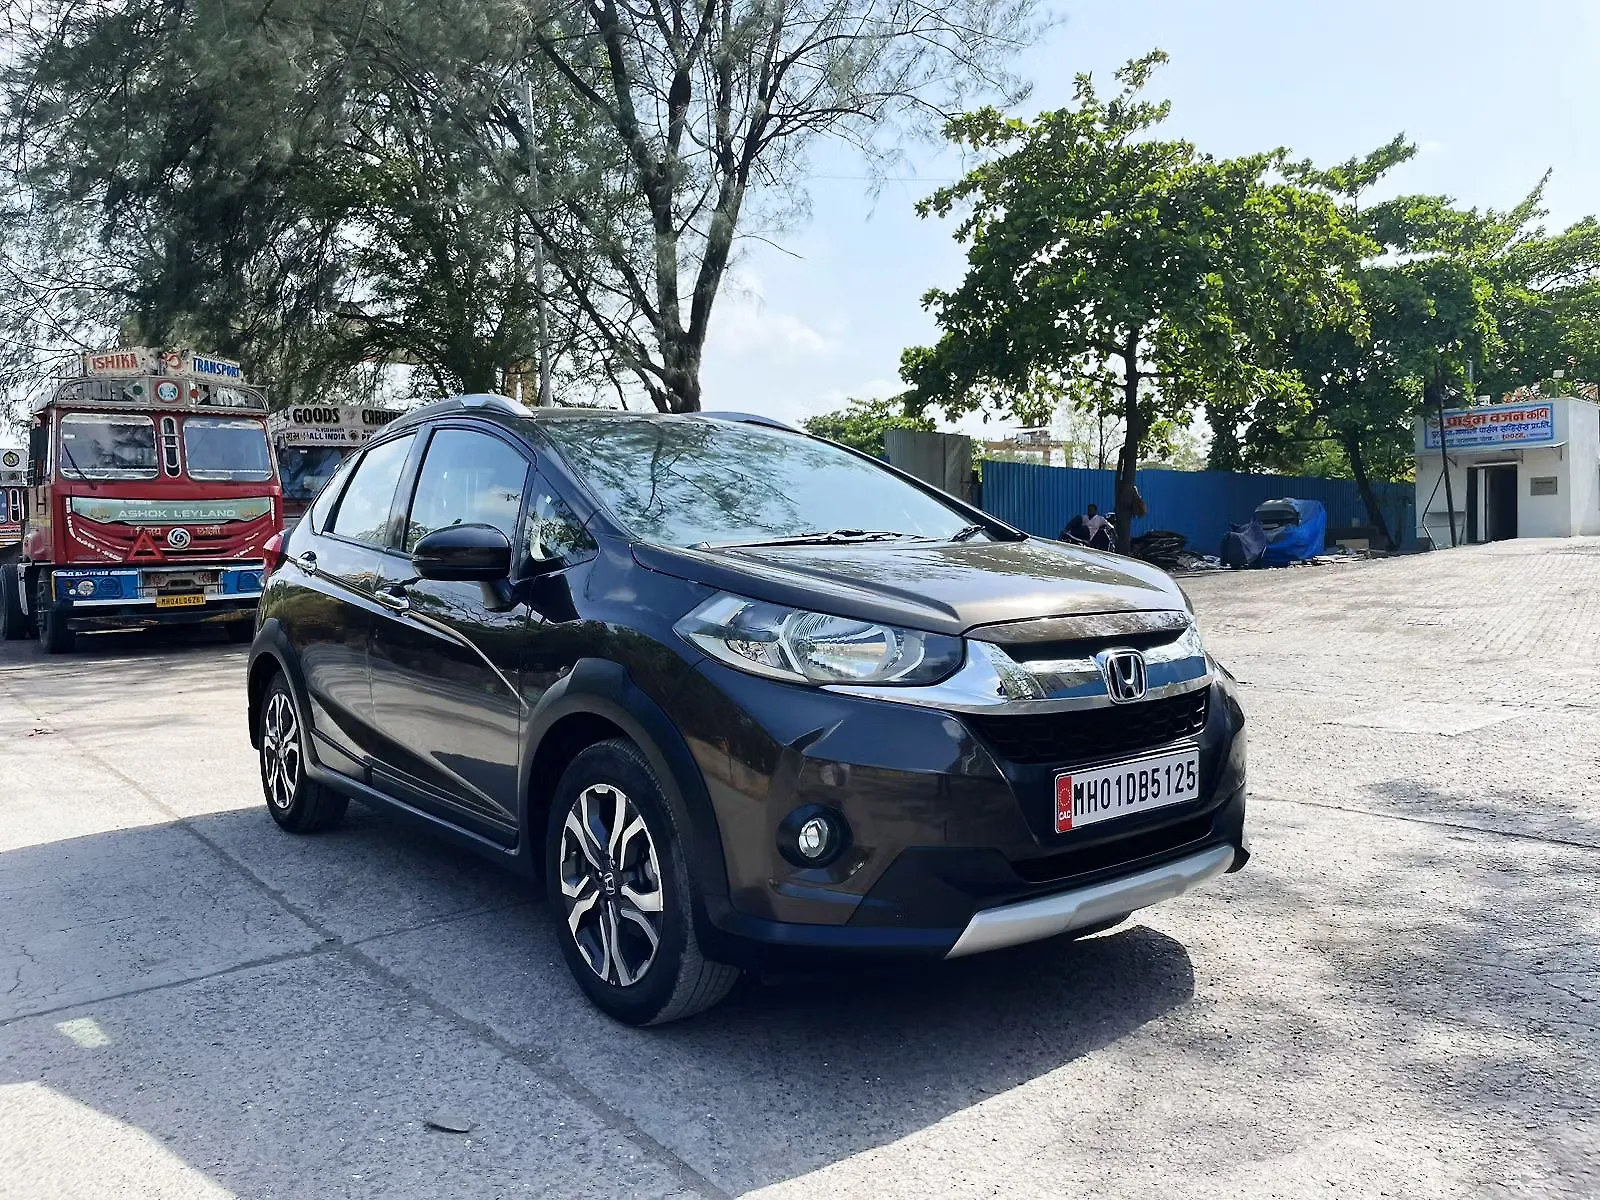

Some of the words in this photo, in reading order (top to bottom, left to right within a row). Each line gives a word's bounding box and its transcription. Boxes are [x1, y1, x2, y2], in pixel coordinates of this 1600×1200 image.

[92, 353, 139, 370] ISHIKA
[193, 357, 240, 377] TRANSPORT
[292, 408, 340, 424] GOODS
[309, 432, 323, 440] ALL
[324, 432, 346, 441] INDIA
[118, 509, 167, 518] ASHOK
[173, 509, 236, 518] LEYLAND
[1073, 759, 1196, 817] MH01DB5125
